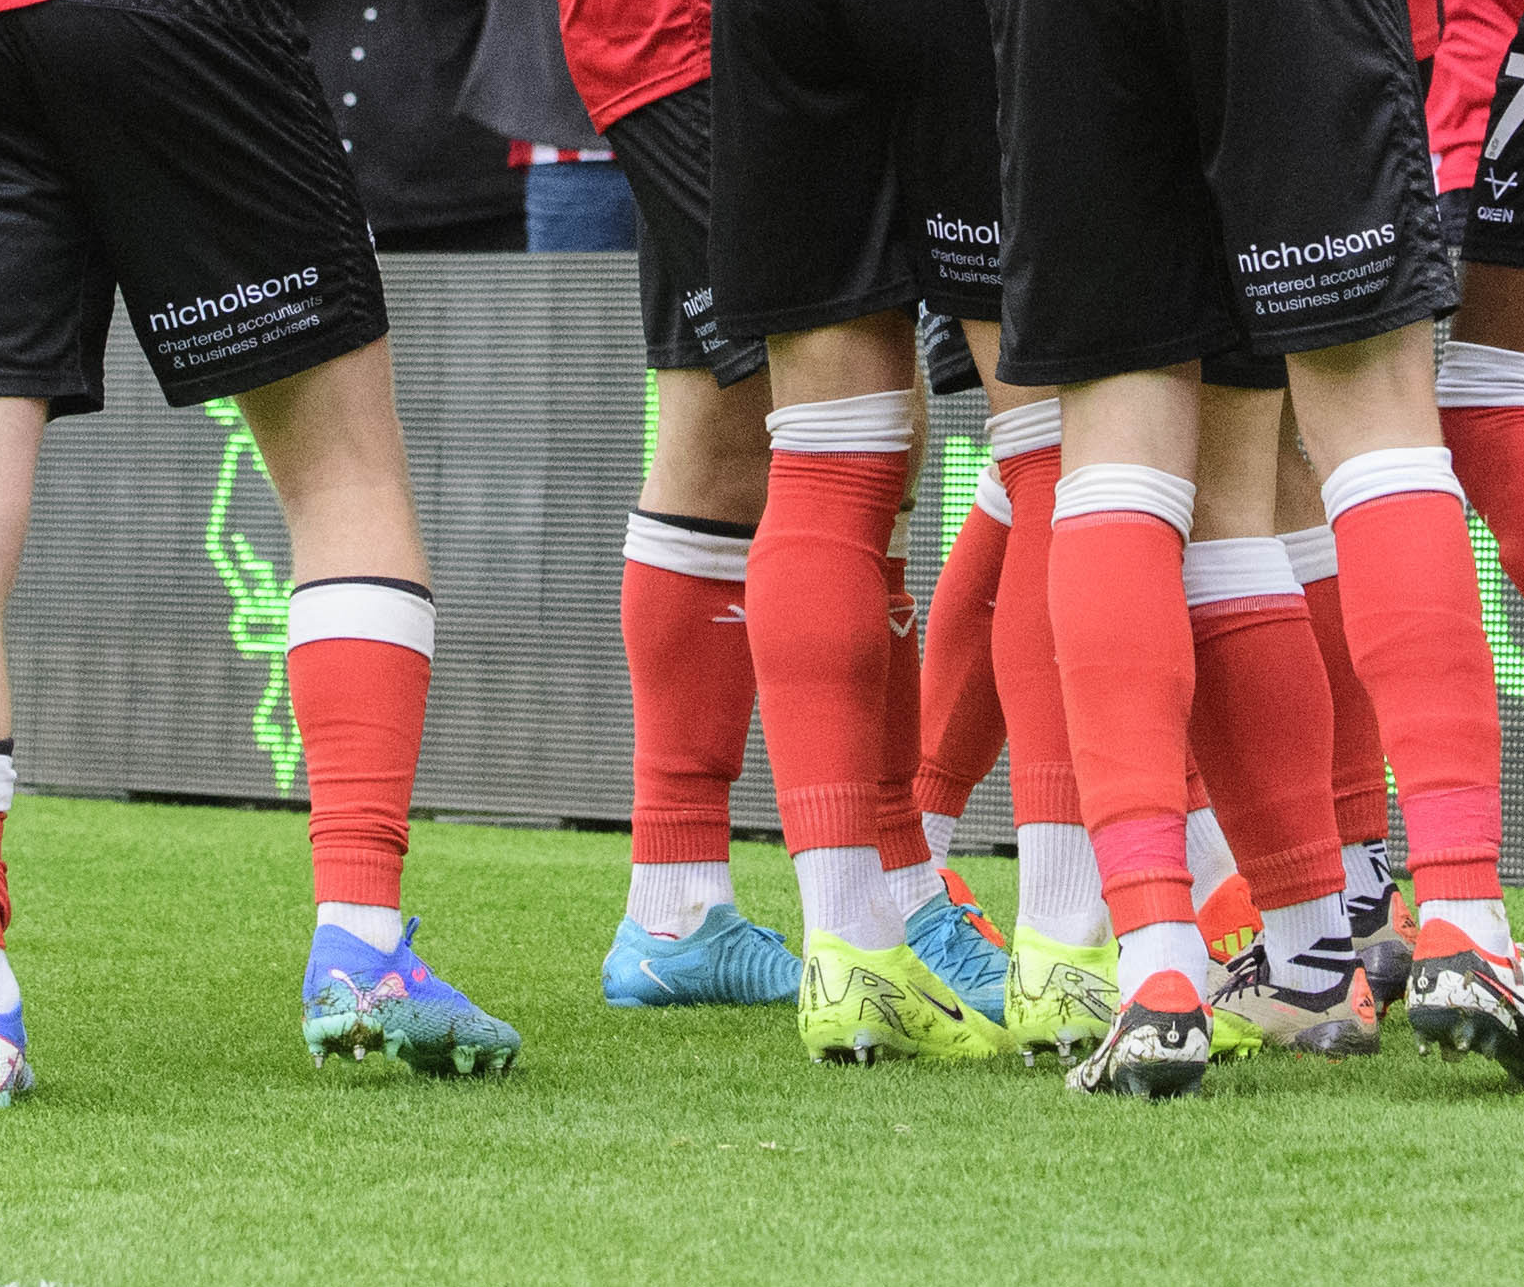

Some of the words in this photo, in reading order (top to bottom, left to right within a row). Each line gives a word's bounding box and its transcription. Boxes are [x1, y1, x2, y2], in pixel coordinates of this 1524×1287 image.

[926, 212, 1000, 245] nichol
[1237, 223, 1396, 273] nicholsons
[939, 264, 948, 279] &
[1244, 273, 1316, 298] chartered
[149, 266, 320, 332] nicholsons
[1255, 300, 1267, 315] &
[1268, 290, 1340, 314] business
[158, 323, 234, 355] chartered
[237, 294, 324, 335] accountants
[173, 355, 186, 370] &
[188, 336, 259, 366] business
[261, 313, 321, 344] advisers
